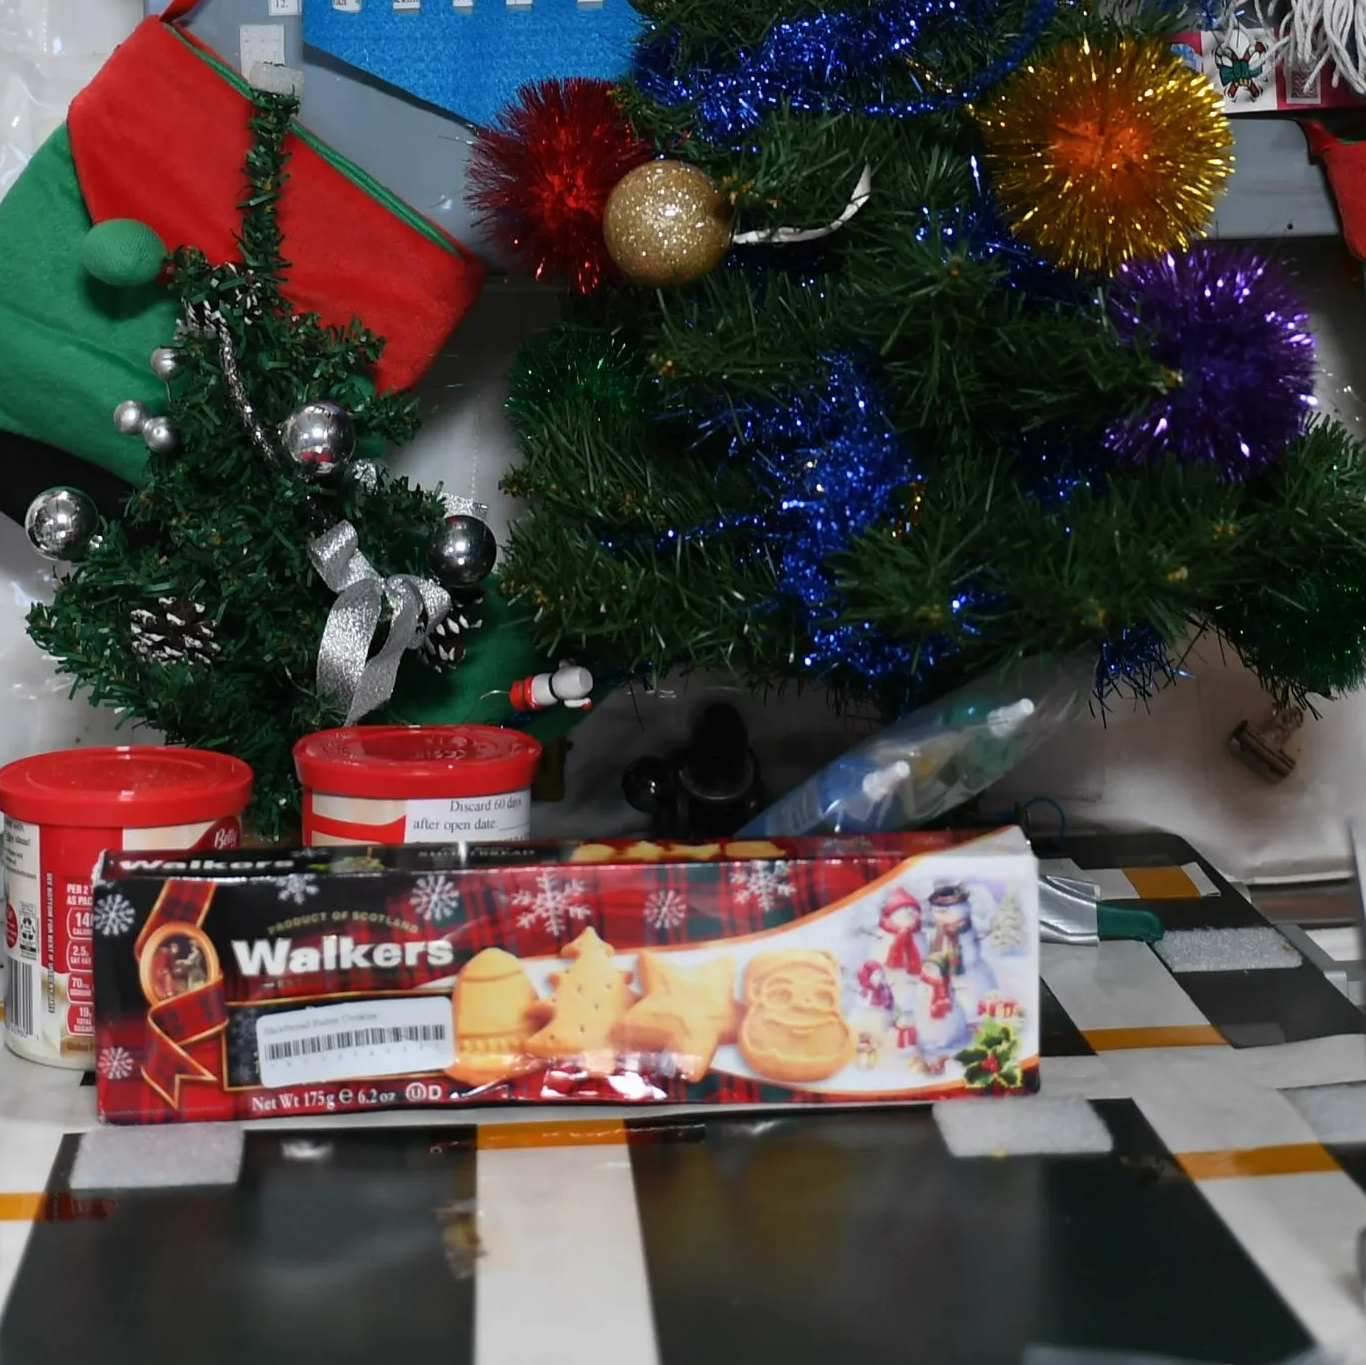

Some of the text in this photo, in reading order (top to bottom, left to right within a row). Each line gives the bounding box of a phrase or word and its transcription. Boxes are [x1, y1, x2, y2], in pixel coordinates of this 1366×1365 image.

[449, 799, 492, 813] Discard
[493, 798, 506, 811] 60
[413, 818, 471, 833] after open
[119, 859, 295, 871] Walkers
[66, 883, 83, 895] PER
[66, 895, 78, 905] AS
[267, 910, 420, 935] PRODUCT OF SCOTLAND
[231, 935, 454, 978] Walkers
[252, 1096, 277, 1112] Net
[279, 1093, 301, 1108] Wt
[303, 1091, 336, 1111] 175g
